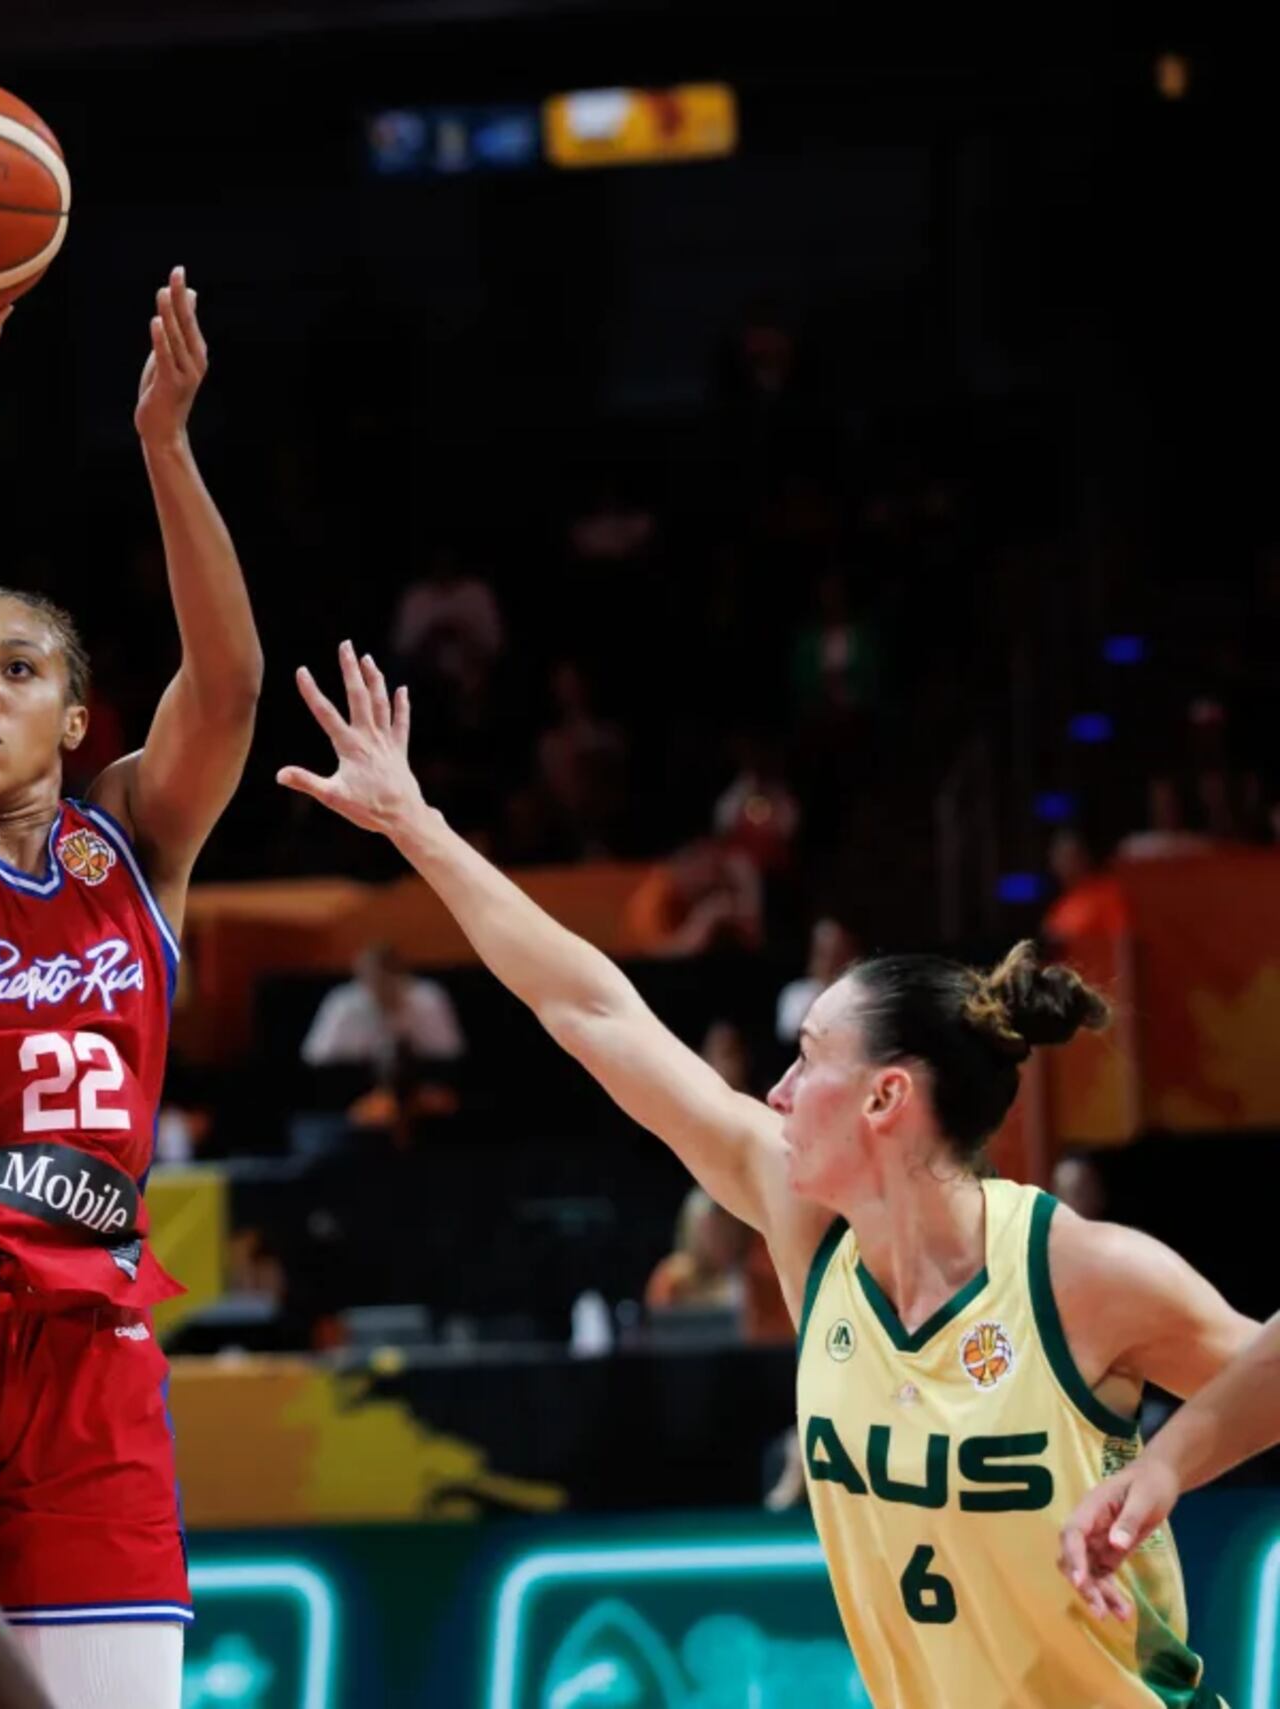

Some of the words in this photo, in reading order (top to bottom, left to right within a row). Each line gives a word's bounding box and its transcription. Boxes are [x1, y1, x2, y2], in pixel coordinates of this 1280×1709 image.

[19, 1032, 131, 1132] 22
[805, 1415, 1054, 1513] AUS
[900, 1544, 958, 1625] 6
